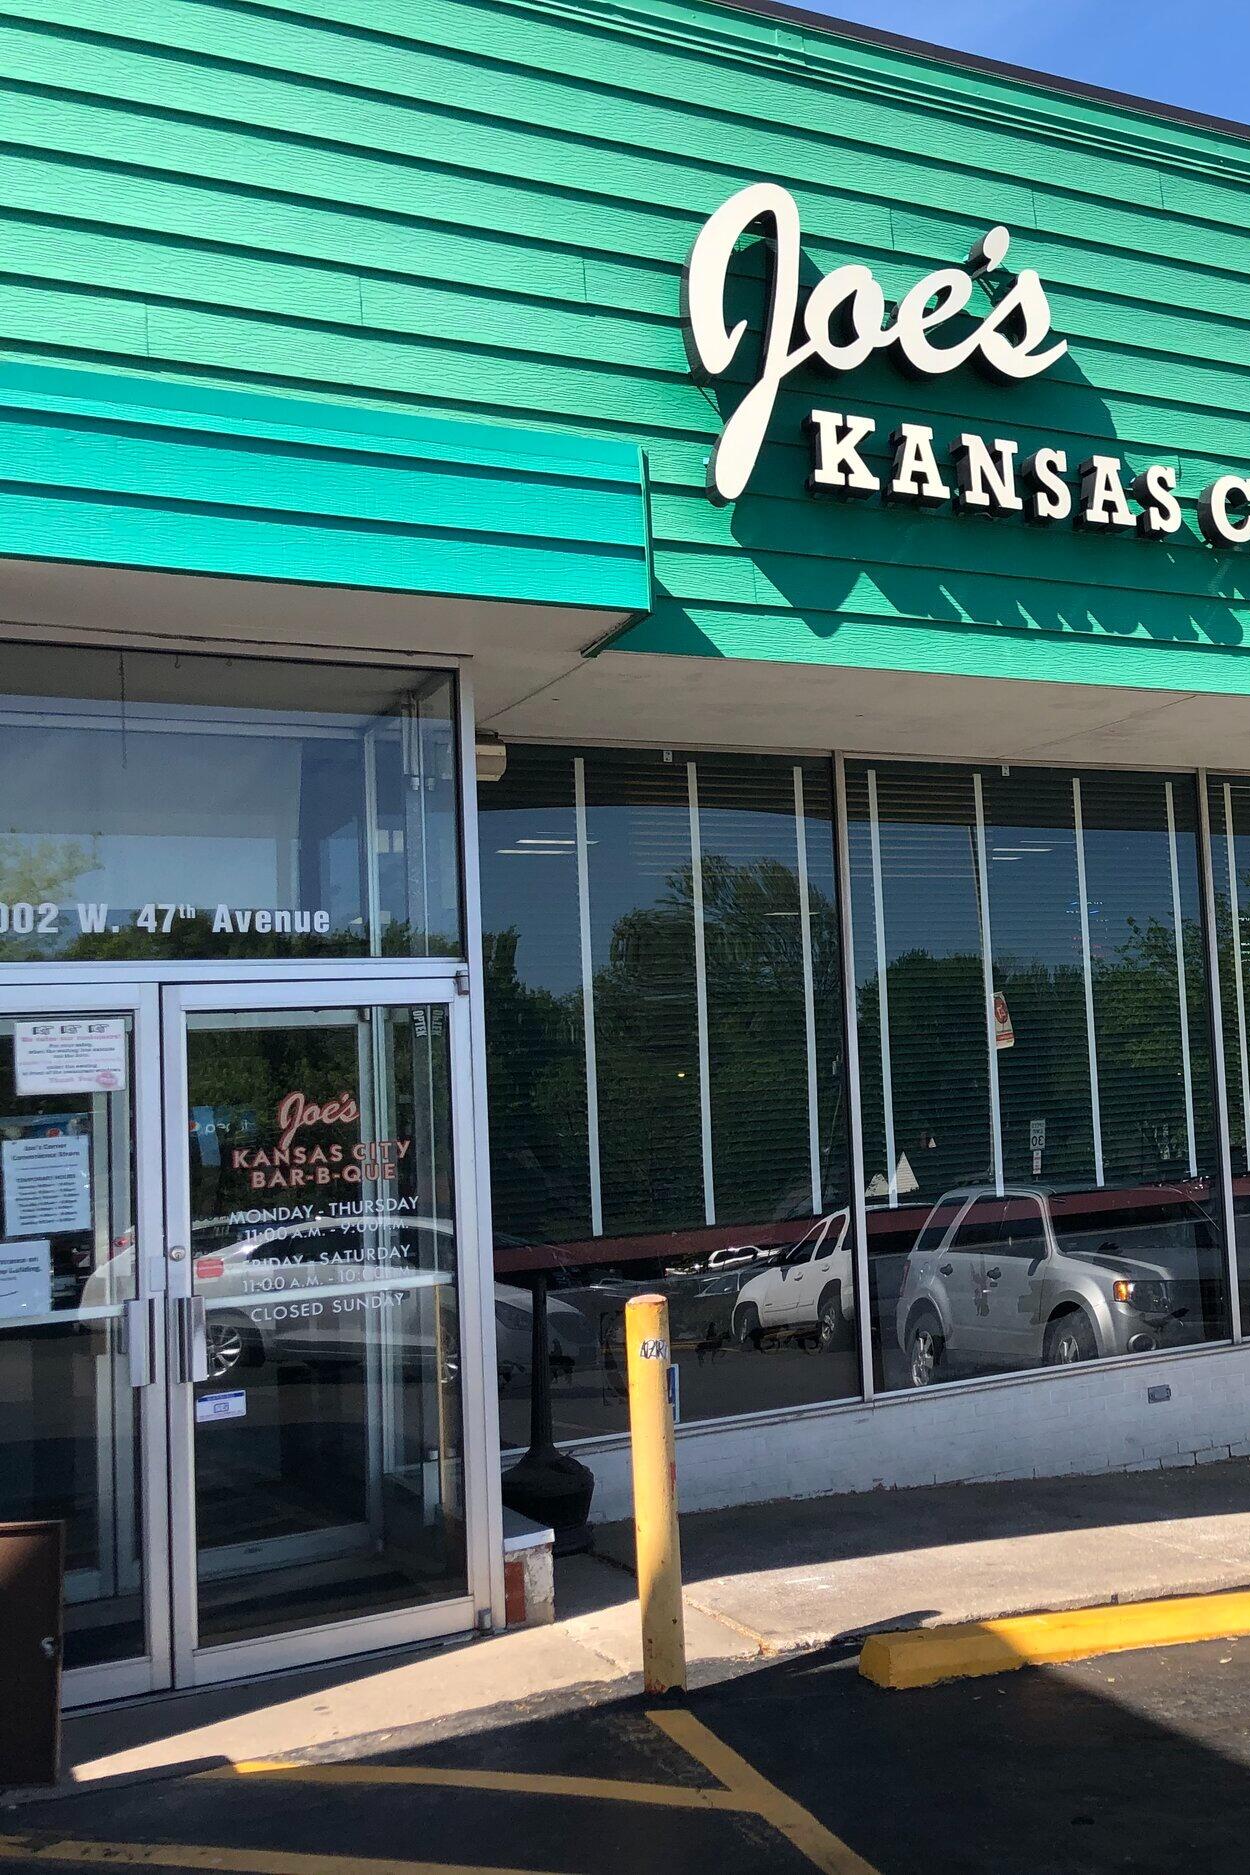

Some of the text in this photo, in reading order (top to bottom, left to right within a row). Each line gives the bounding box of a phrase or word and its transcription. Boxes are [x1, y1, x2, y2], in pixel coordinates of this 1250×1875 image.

[685, 182, 1067, 504] Joe's
[806, 408, 1182, 541] KANSAS
[77, 903, 120, 933] W.
[137, 903, 197, 934] 47th
[213, 903, 331, 934] Avenue
[277, 1091, 360, 1150] Joe's
[232, 1140, 411, 1169] KANSAS CITY
[250, 1162, 396, 1188] BAR-B-QUE
[229, 1204, 314, 1226] MONDAY
[329, 1195, 420, 1217] THURSDAY
[244, 1227, 287, 1244] 11:00
[292, 1226, 326, 1239] A.M.
[320, 1244, 411, 1267] SATURDAY
[242, 1276, 285, 1294] 11:00
[290, 1274, 325, 1290] A.M.
[251, 1292, 405, 1323] CLOSED SUNDAY
